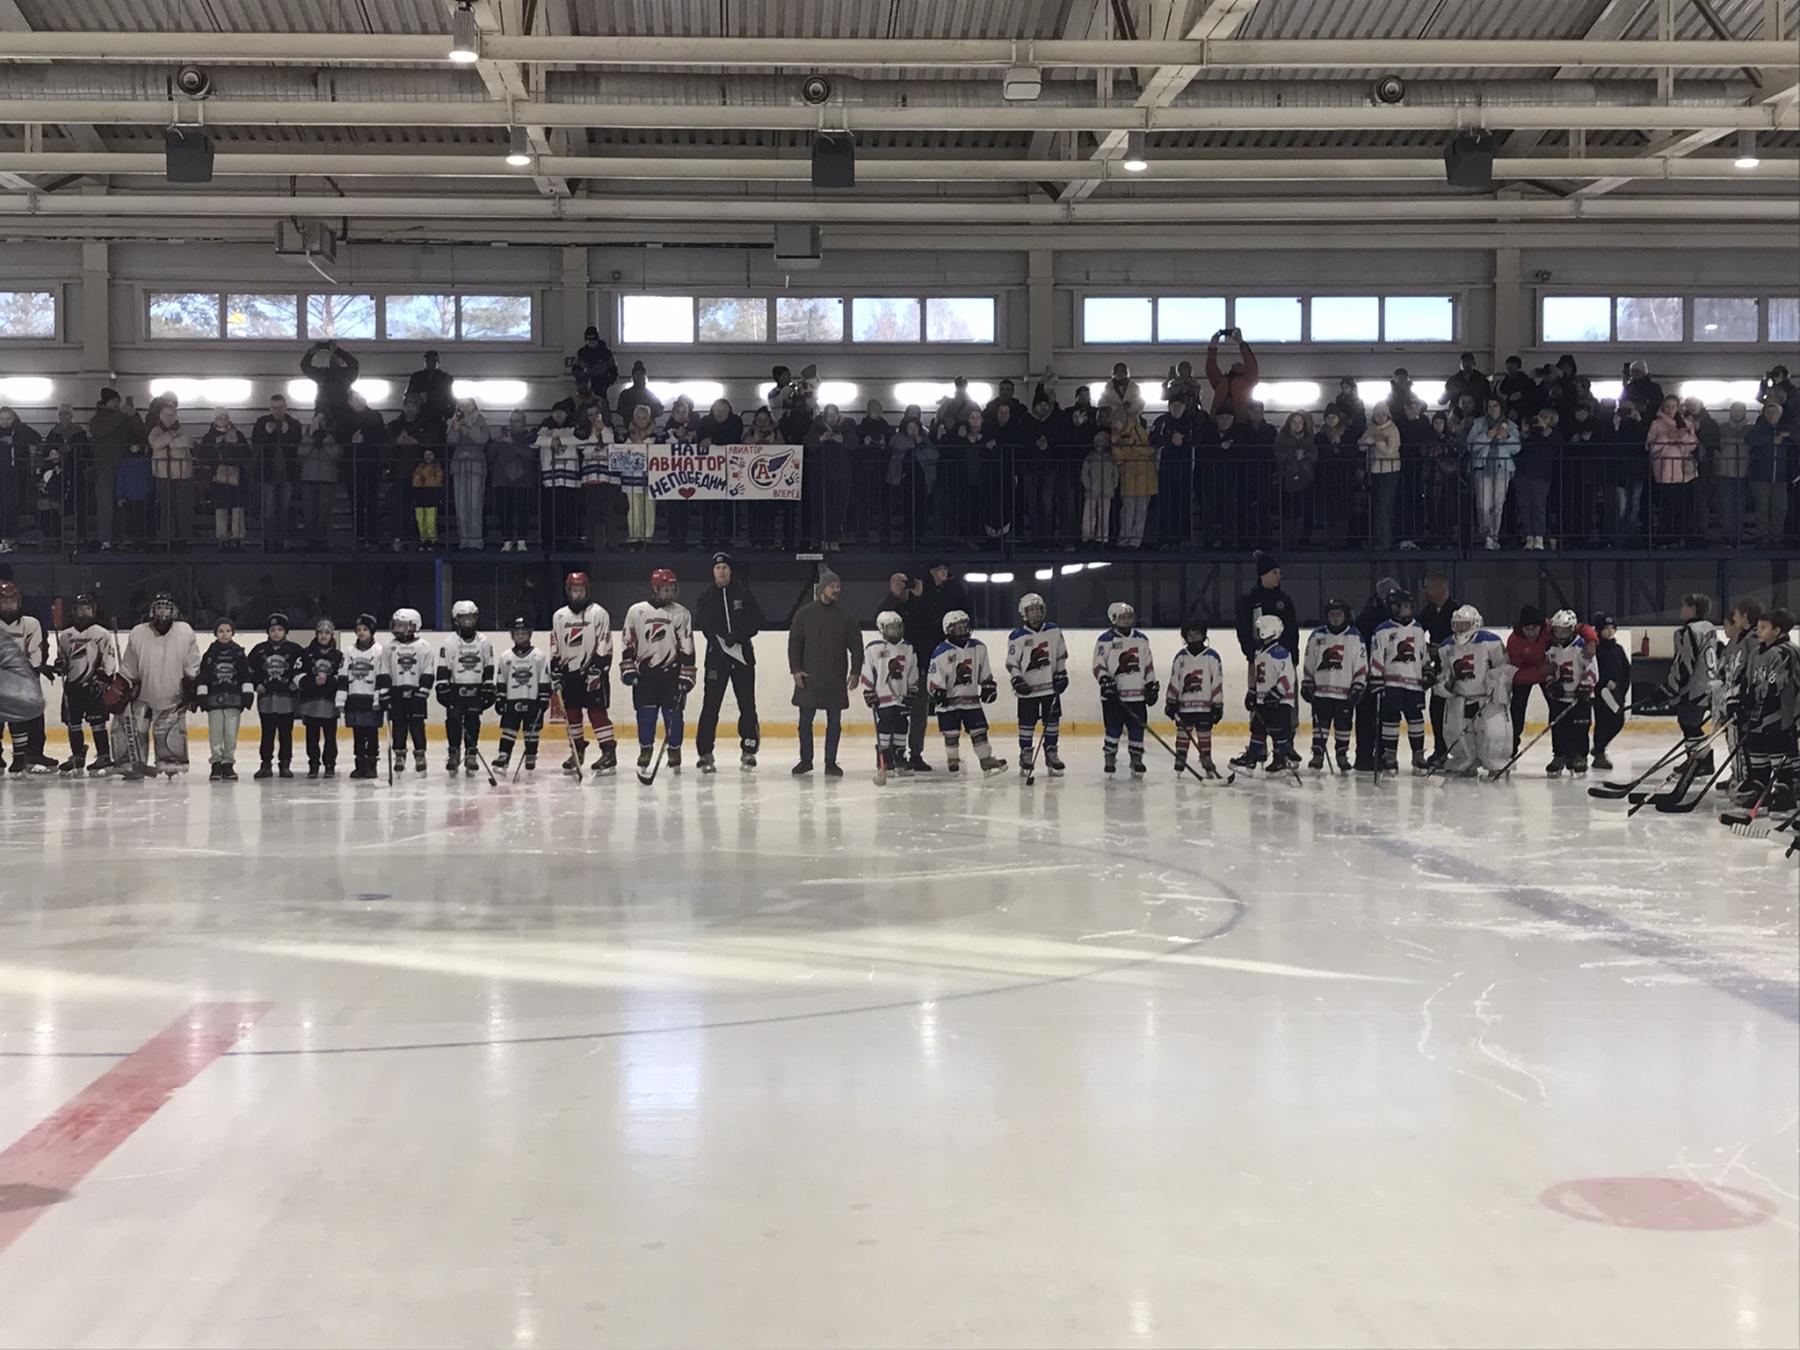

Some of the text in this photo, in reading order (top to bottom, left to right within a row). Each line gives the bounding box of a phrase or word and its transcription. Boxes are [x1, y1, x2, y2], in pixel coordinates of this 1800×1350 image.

[729, 446, 763, 455] АВИАТОР
[649, 455, 726, 471] АВИАТОР
[649, 470, 727, 498] НЕПОБЕДИМ
